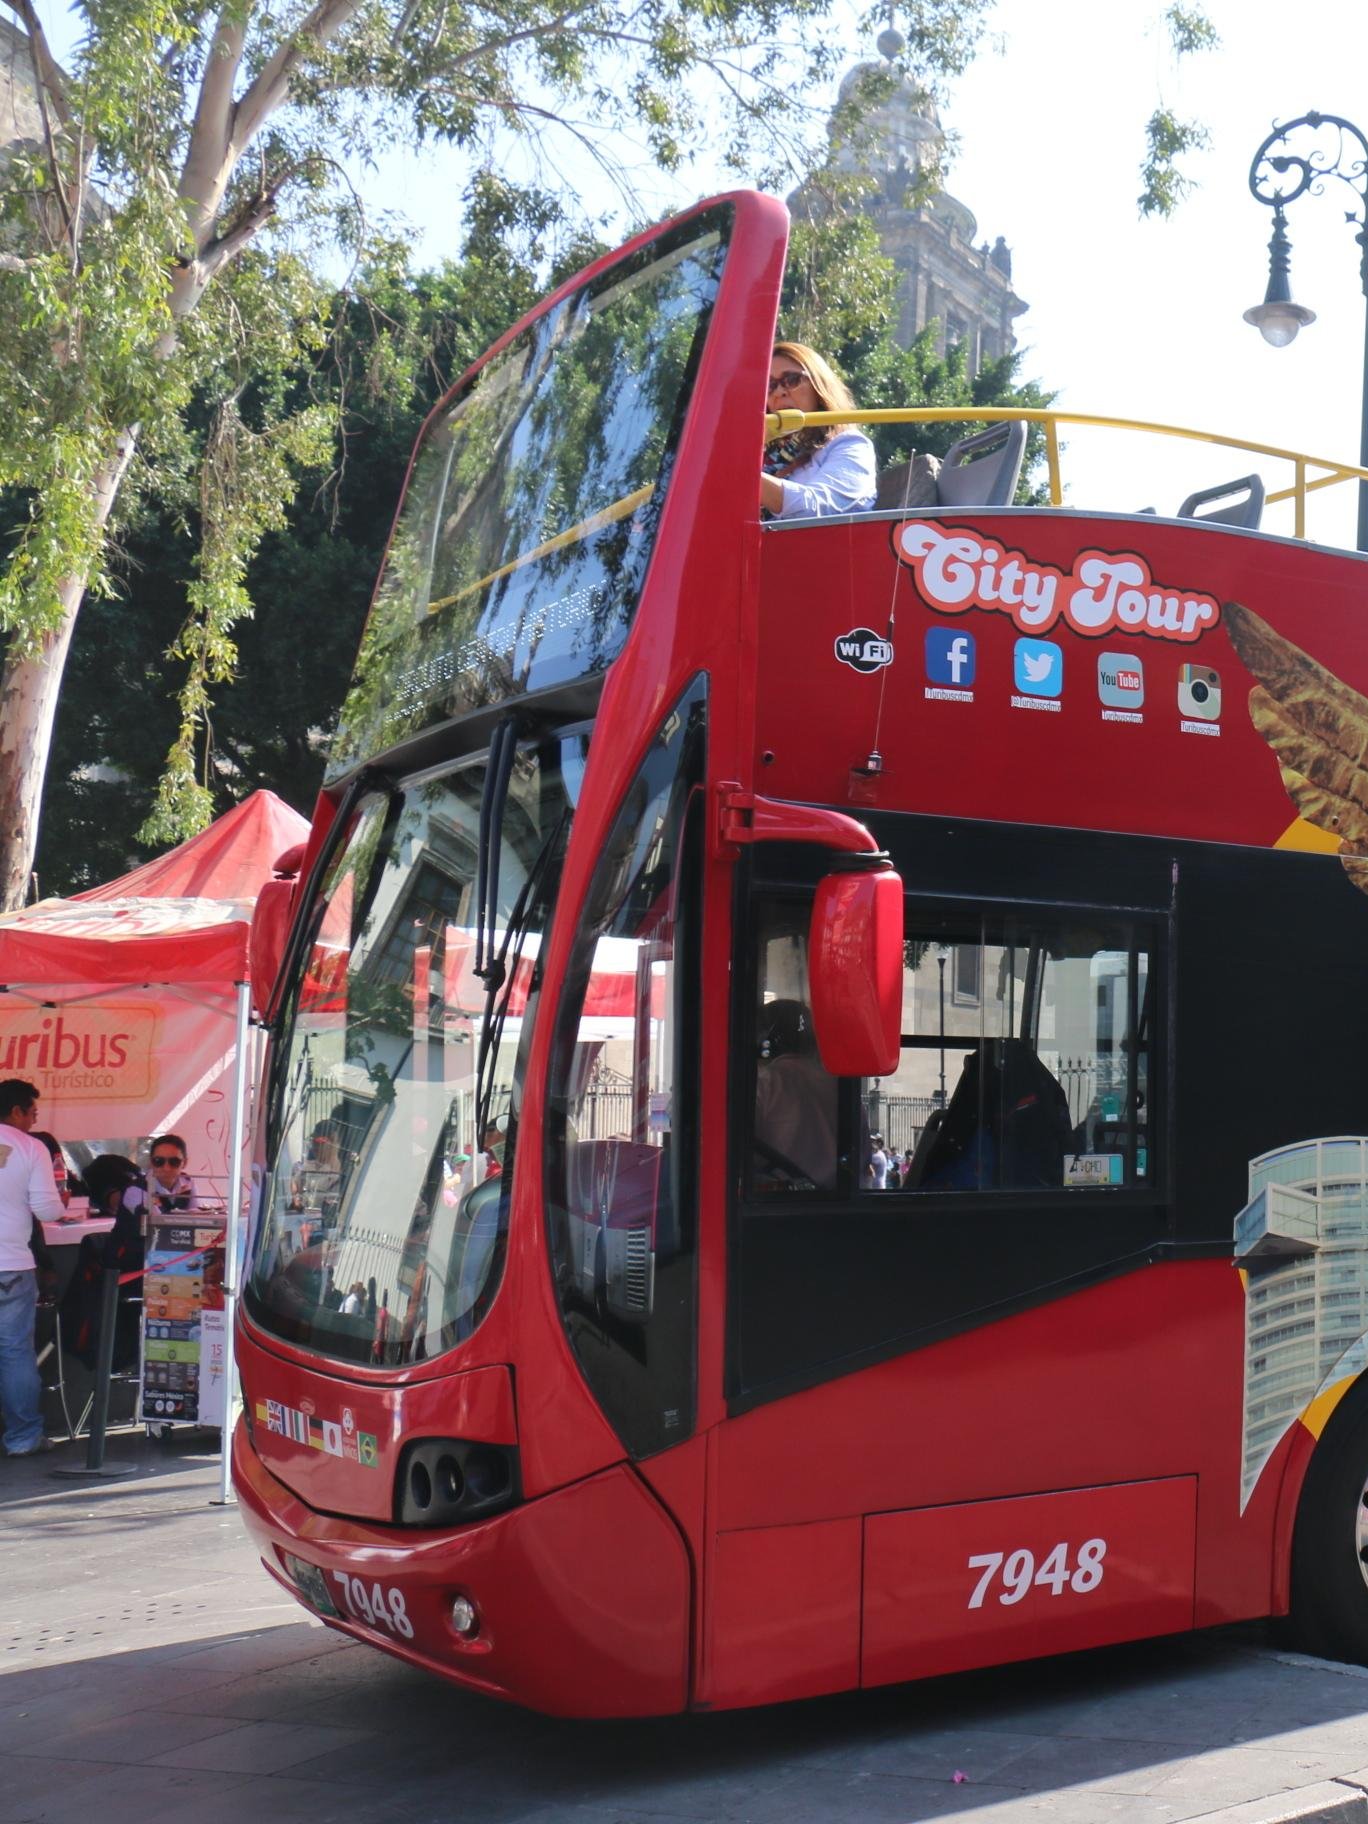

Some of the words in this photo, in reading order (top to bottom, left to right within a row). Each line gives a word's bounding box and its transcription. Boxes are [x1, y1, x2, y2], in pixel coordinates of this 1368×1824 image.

[901, 524, 1057, 625] City
[1070, 559, 1212, 632] Tour
[0, 1017, 130, 1070] uribus
[42, 1071, 115, 1090] Turístico
[333, 1570, 415, 1638] 7948
[968, 1538, 1107, 1609] 7948
